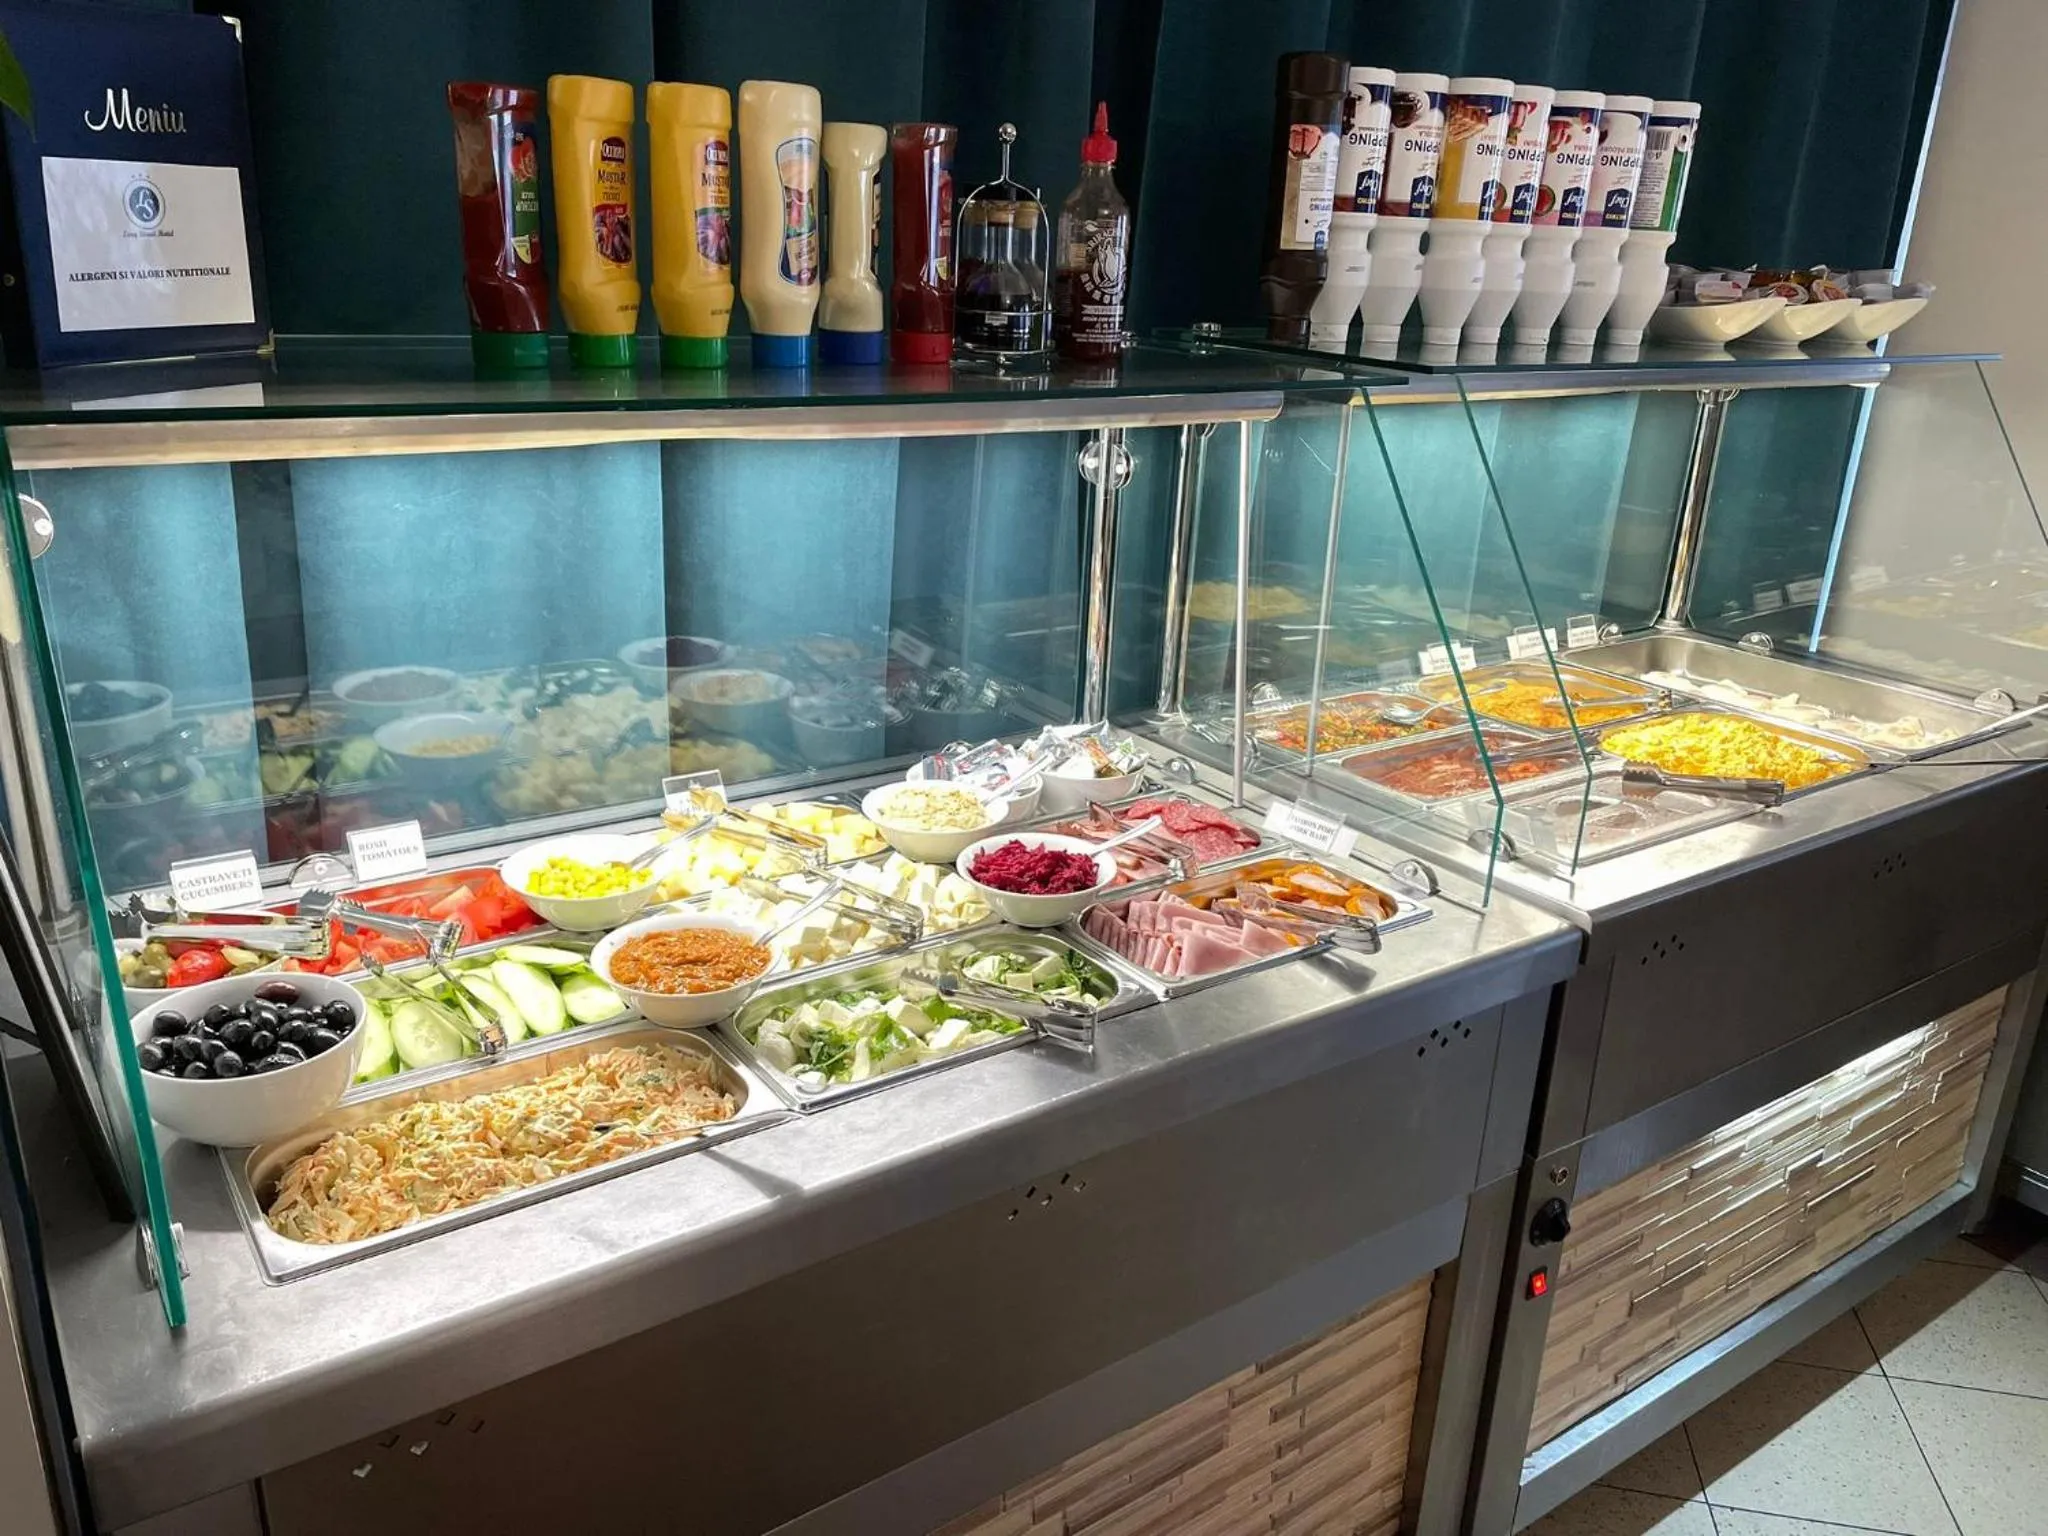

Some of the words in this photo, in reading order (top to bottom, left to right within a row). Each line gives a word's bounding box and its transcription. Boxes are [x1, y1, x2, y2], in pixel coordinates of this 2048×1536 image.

[84, 88, 186, 132] Meniu
[69, 271, 117, 282] ALERGENI
[130, 268, 164, 279] VALORI
[166, 266, 231, 278] NUTRITIONALE
[361, 845, 419, 862] TOMATOES
[178, 868, 252, 889] CASTRAVETI
[180, 881, 254, 901] CUCUMBERS
